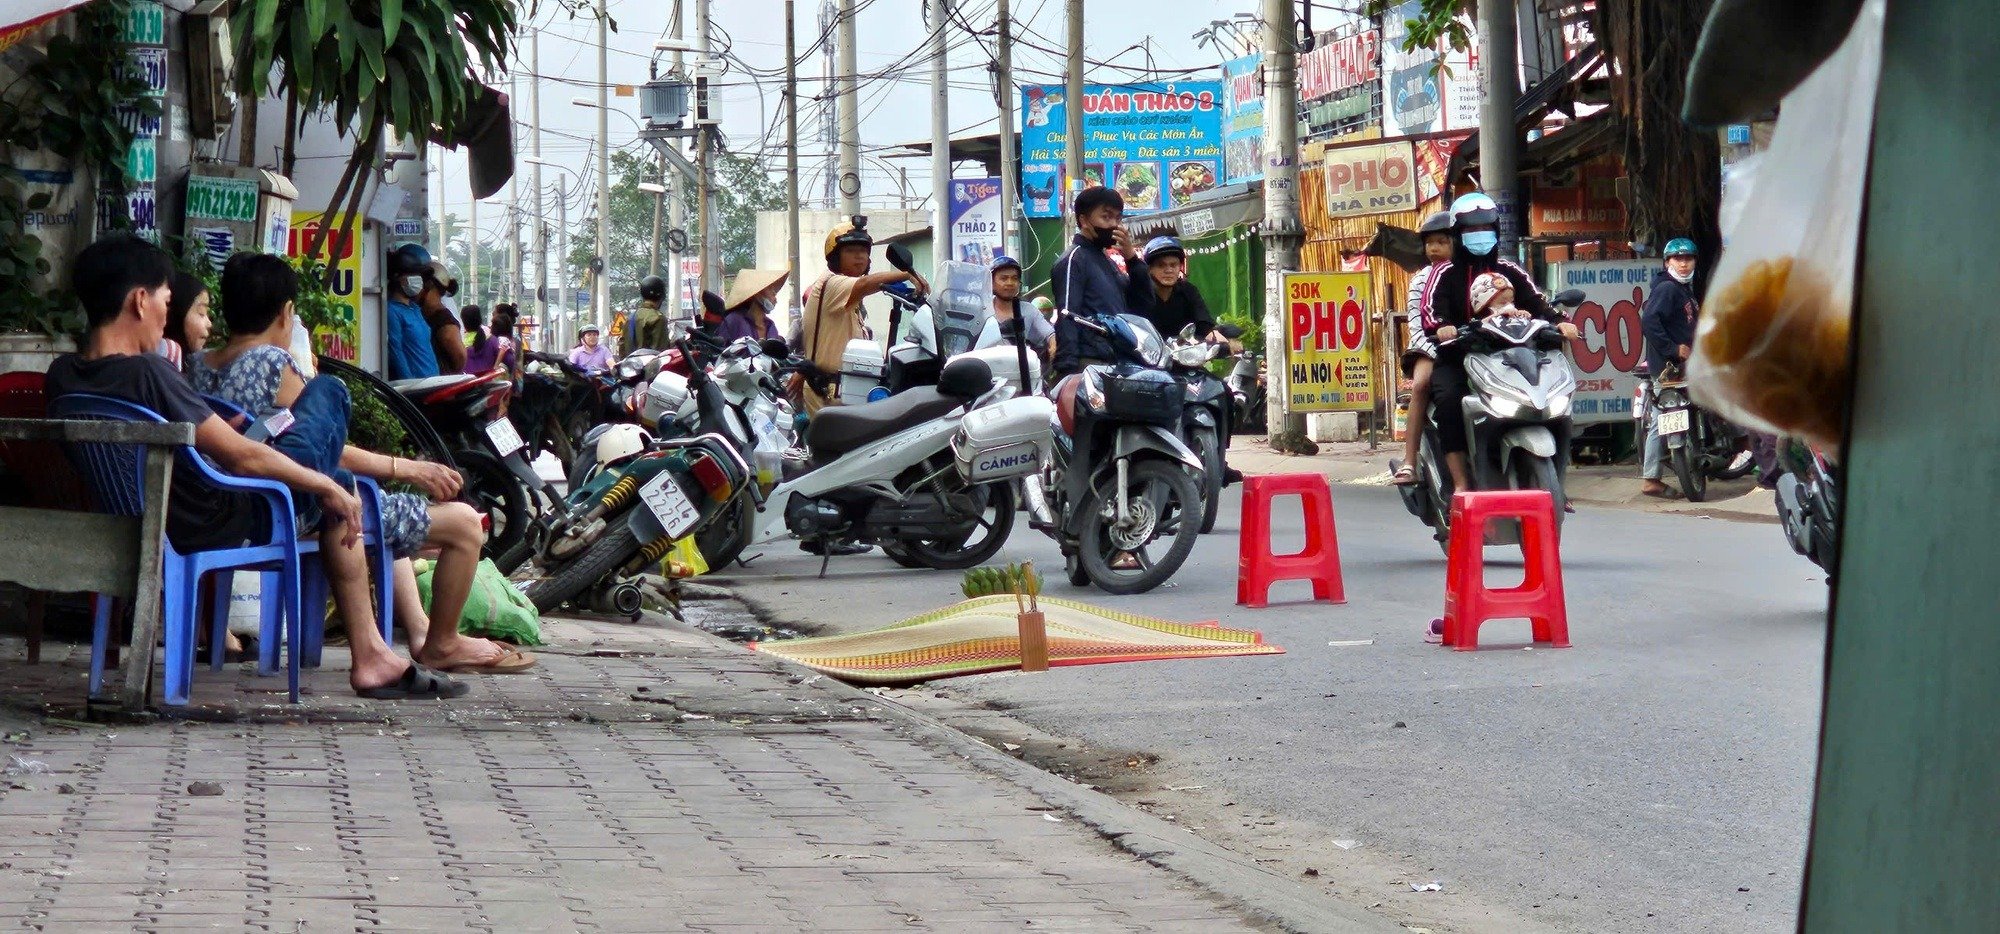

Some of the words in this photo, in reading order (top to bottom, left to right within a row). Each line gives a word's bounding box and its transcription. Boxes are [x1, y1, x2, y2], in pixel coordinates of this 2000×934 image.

[1366, 31, 1376, 80] 2
[1083, 88, 1129, 113] UÁN
[1133, 85, 1195, 111] THẢO
[1199, 92, 1213, 110] 2
[1183, 145, 1191, 157] 3
[966, 181, 998, 199] Tiger
[1369, 191, 1412, 208] NỘI
[958, 218, 986, 233] THẢO
[990, 222, 997, 233] 2
[1567, 268, 1597, 285] QUÁN
[1600, 267, 1628, 284] CƠM
[1627, 266, 1648, 282] QUÊ
[1291, 282, 1321, 299] 30K
[1291, 285, 1366, 351] PHỞ
[1569, 286, 1644, 374] CƠ
[1292, 359, 1308, 384] HÀ
[1310, 359, 1332, 389] NỘI
[1575, 378, 1615, 393] 25K
[1602, 396, 1632, 413] THÊM
[980, 455, 1018, 471] CẢNH
